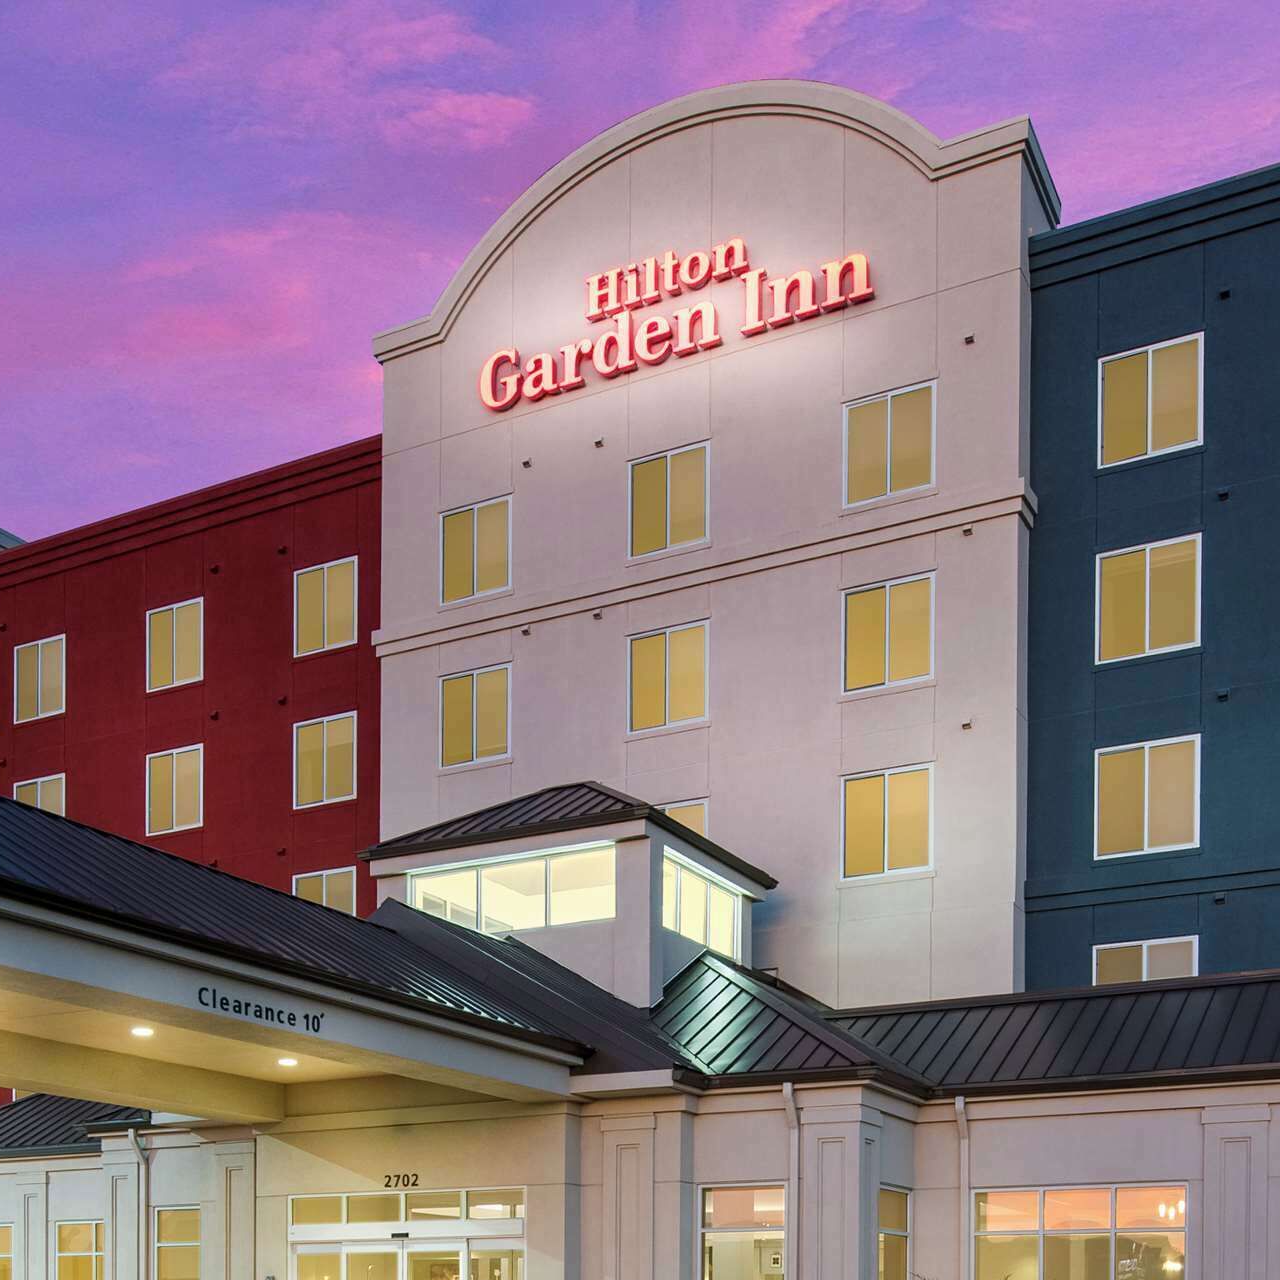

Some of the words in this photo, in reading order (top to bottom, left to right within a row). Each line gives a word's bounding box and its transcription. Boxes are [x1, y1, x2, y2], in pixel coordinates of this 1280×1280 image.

[584, 236, 748, 323] Hilton
[478, 299, 723, 412] Garden
[738, 250, 876, 337] Inn
[198, 987, 297, 1026] Clearance
[384, 1173, 419, 1188] 2702
